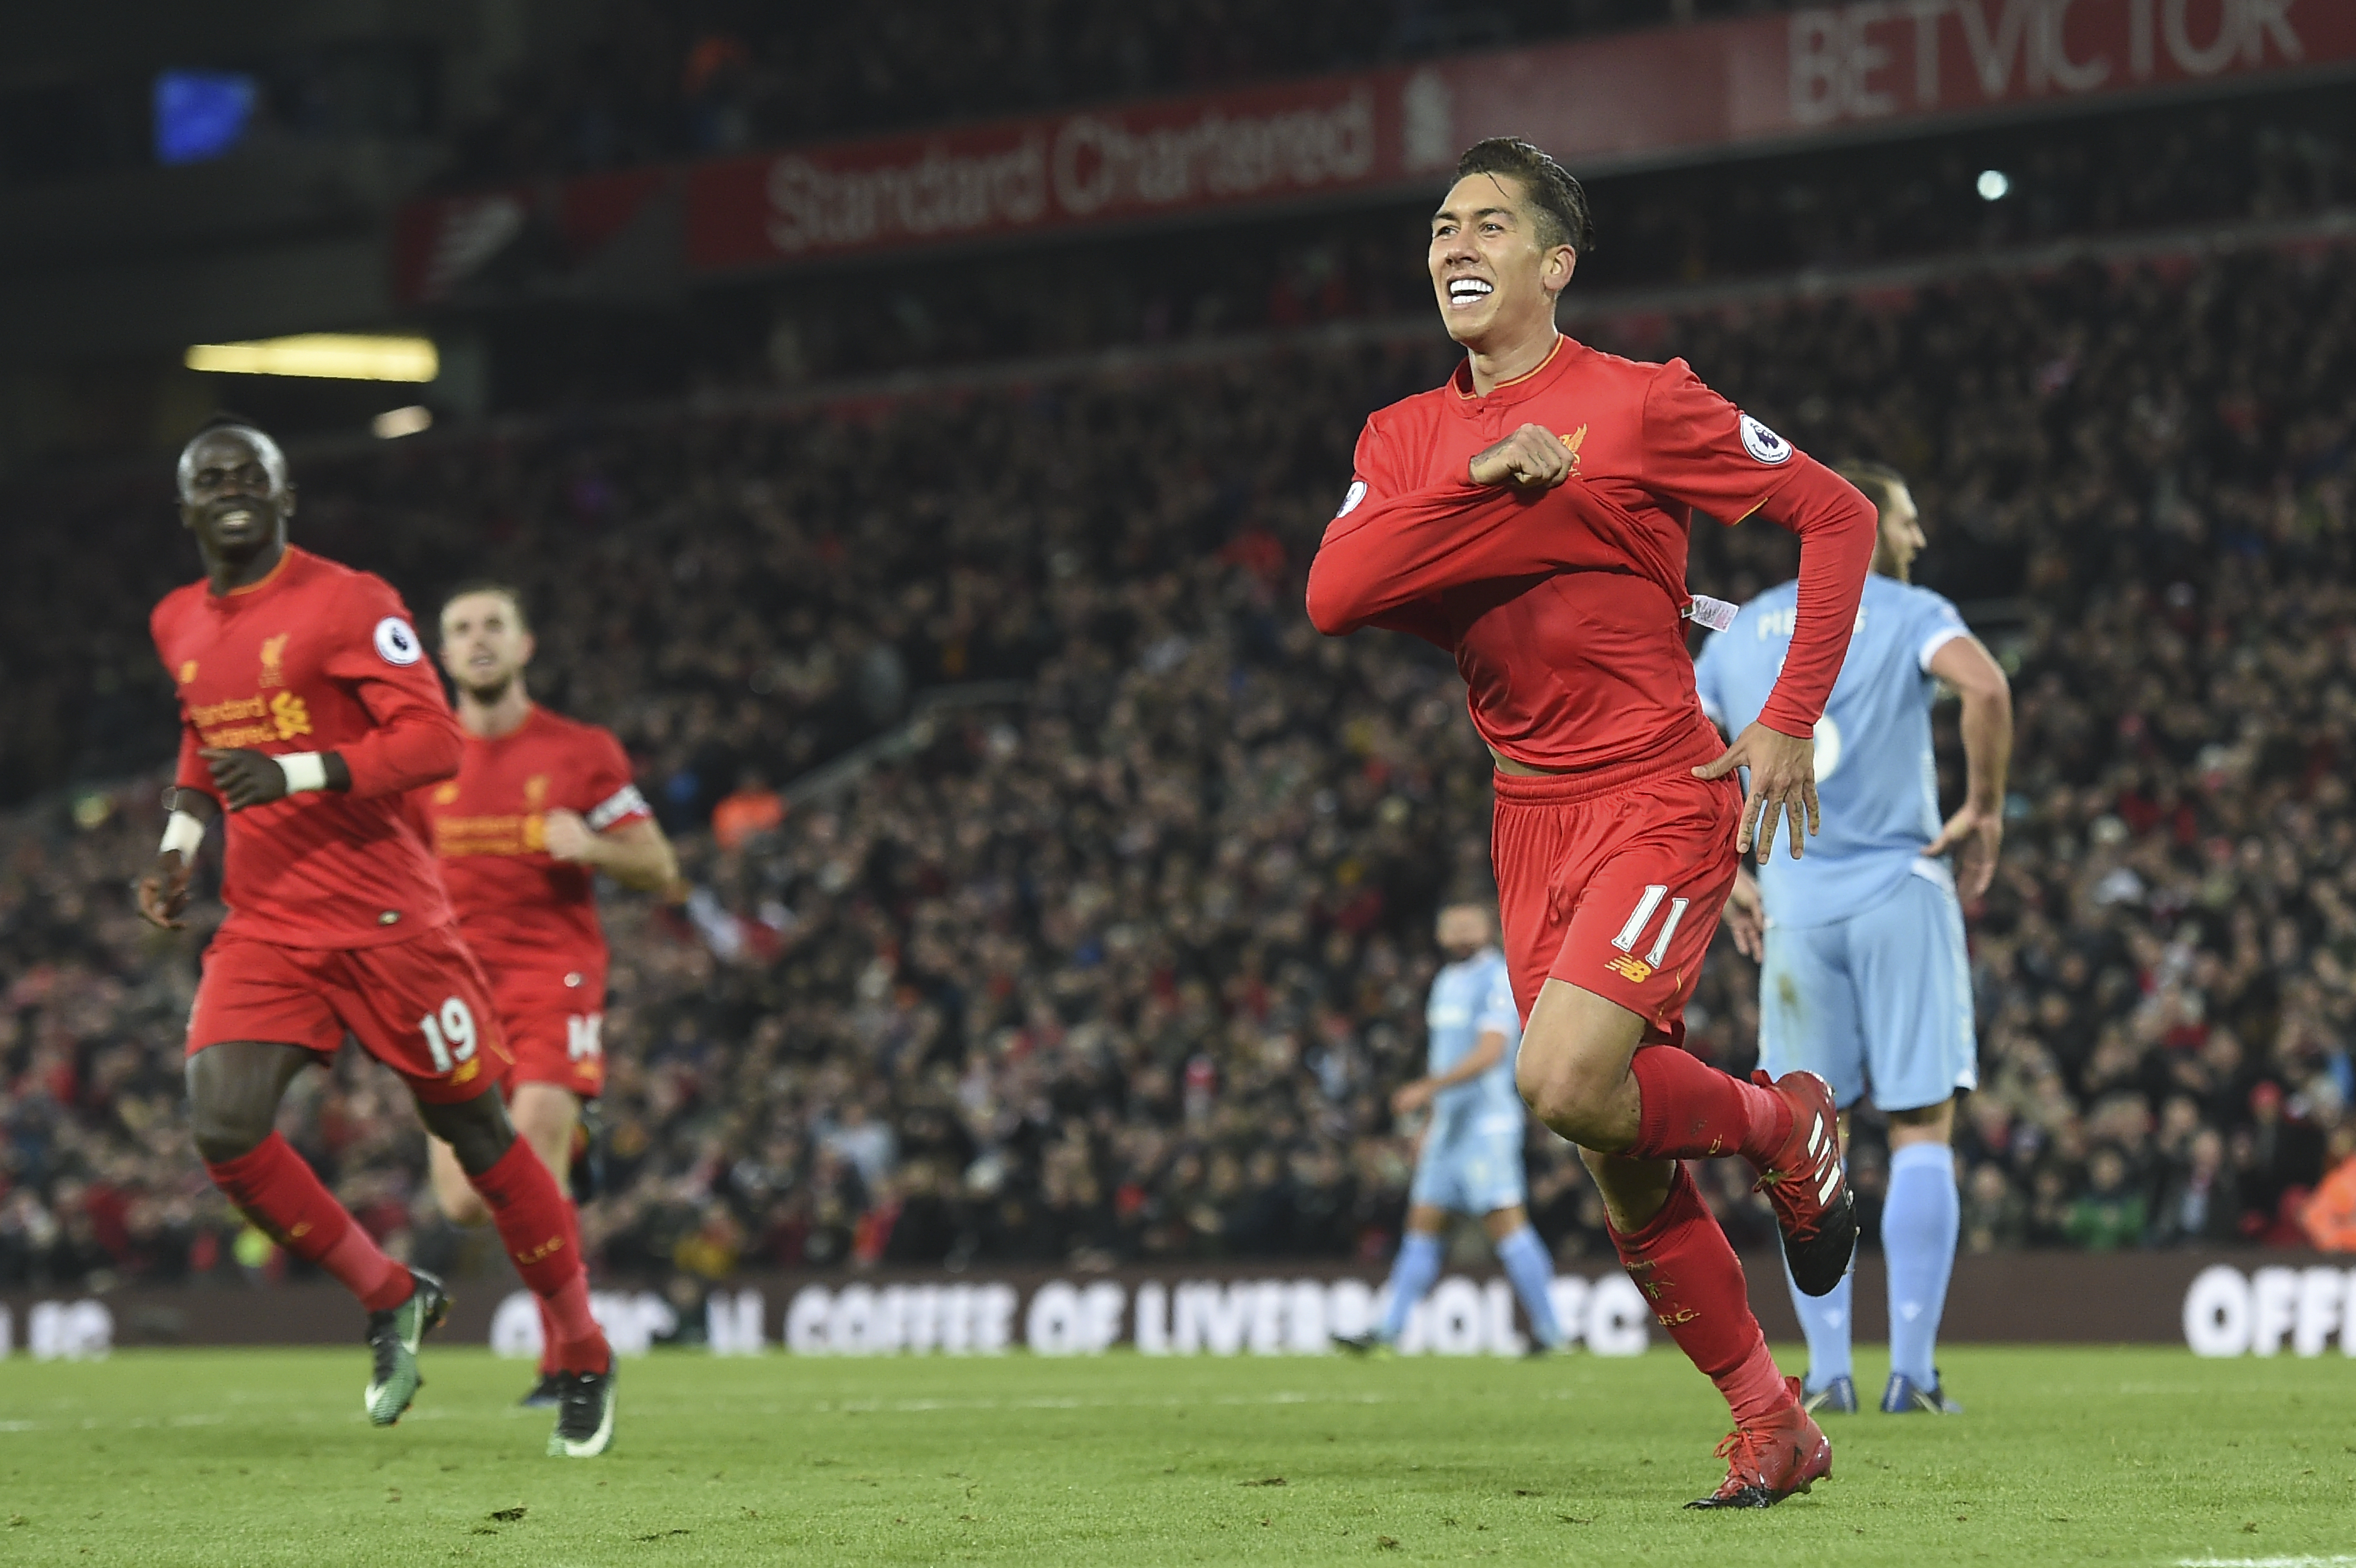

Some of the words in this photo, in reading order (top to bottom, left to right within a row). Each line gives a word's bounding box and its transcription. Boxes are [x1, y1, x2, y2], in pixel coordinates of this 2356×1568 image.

[765, 133, 1047, 253] Standard
[1053, 86, 1375, 215] Chartered
[1611, 884, 1690, 969] 11
[417, 996, 477, 1072] 19
[784, 1284, 1019, 1357] COFFEE
[1026, 1281, 1124, 1356] OF
